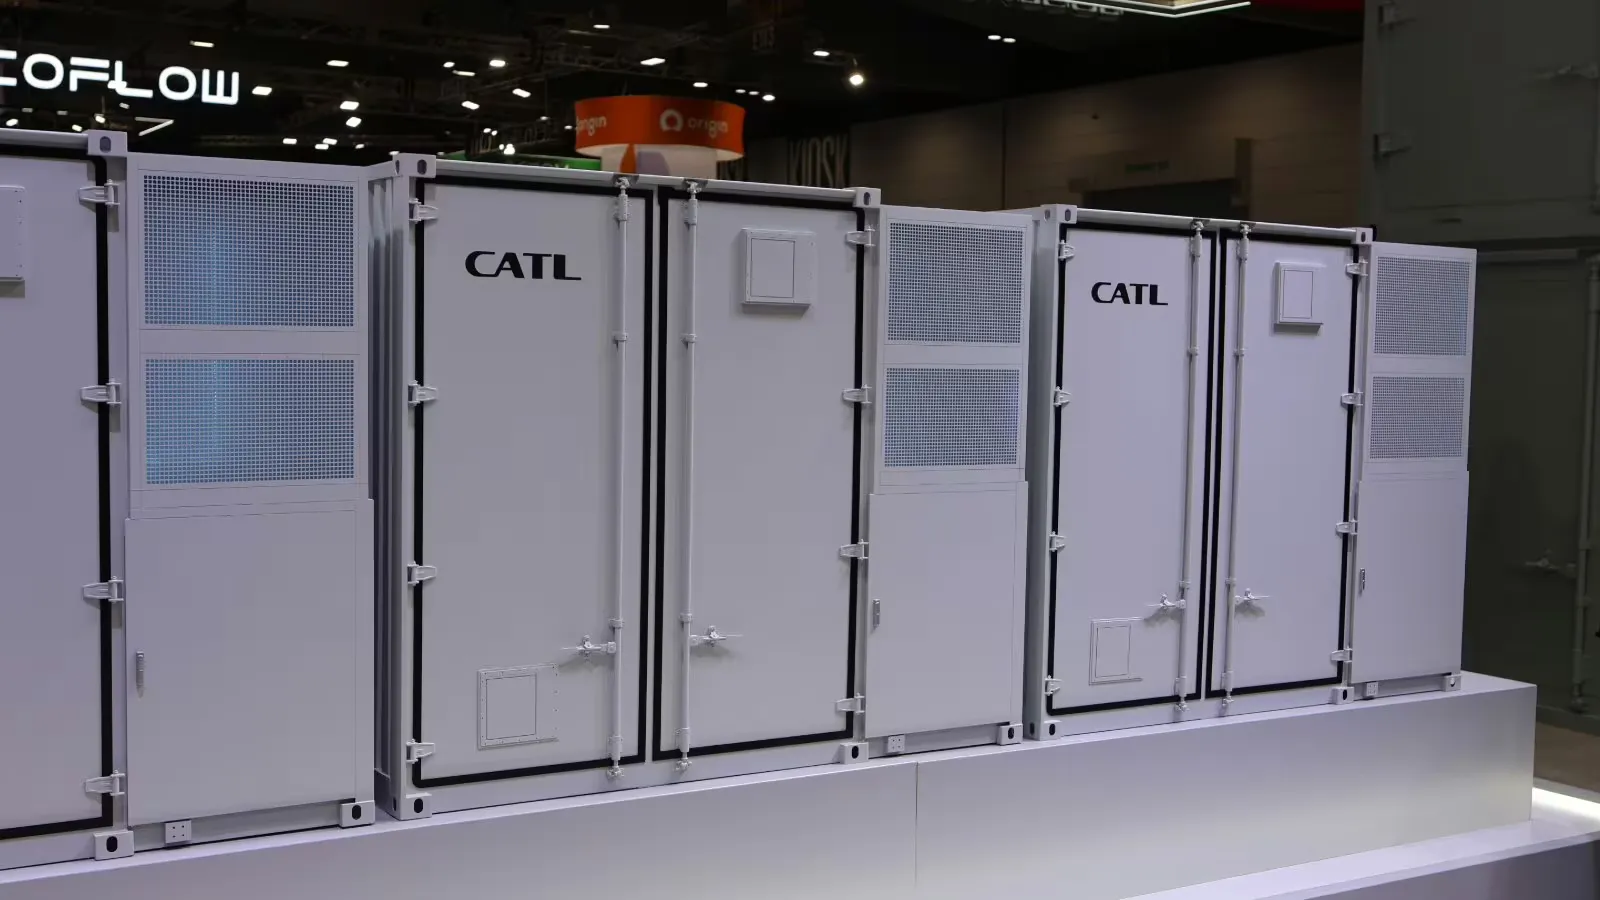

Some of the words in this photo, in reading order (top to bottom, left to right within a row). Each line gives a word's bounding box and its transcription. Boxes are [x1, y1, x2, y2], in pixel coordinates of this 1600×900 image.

[687, 116, 728, 139] origin
[465, 250, 582, 281] CATL
[1091, 281, 1169, 306] CATL
